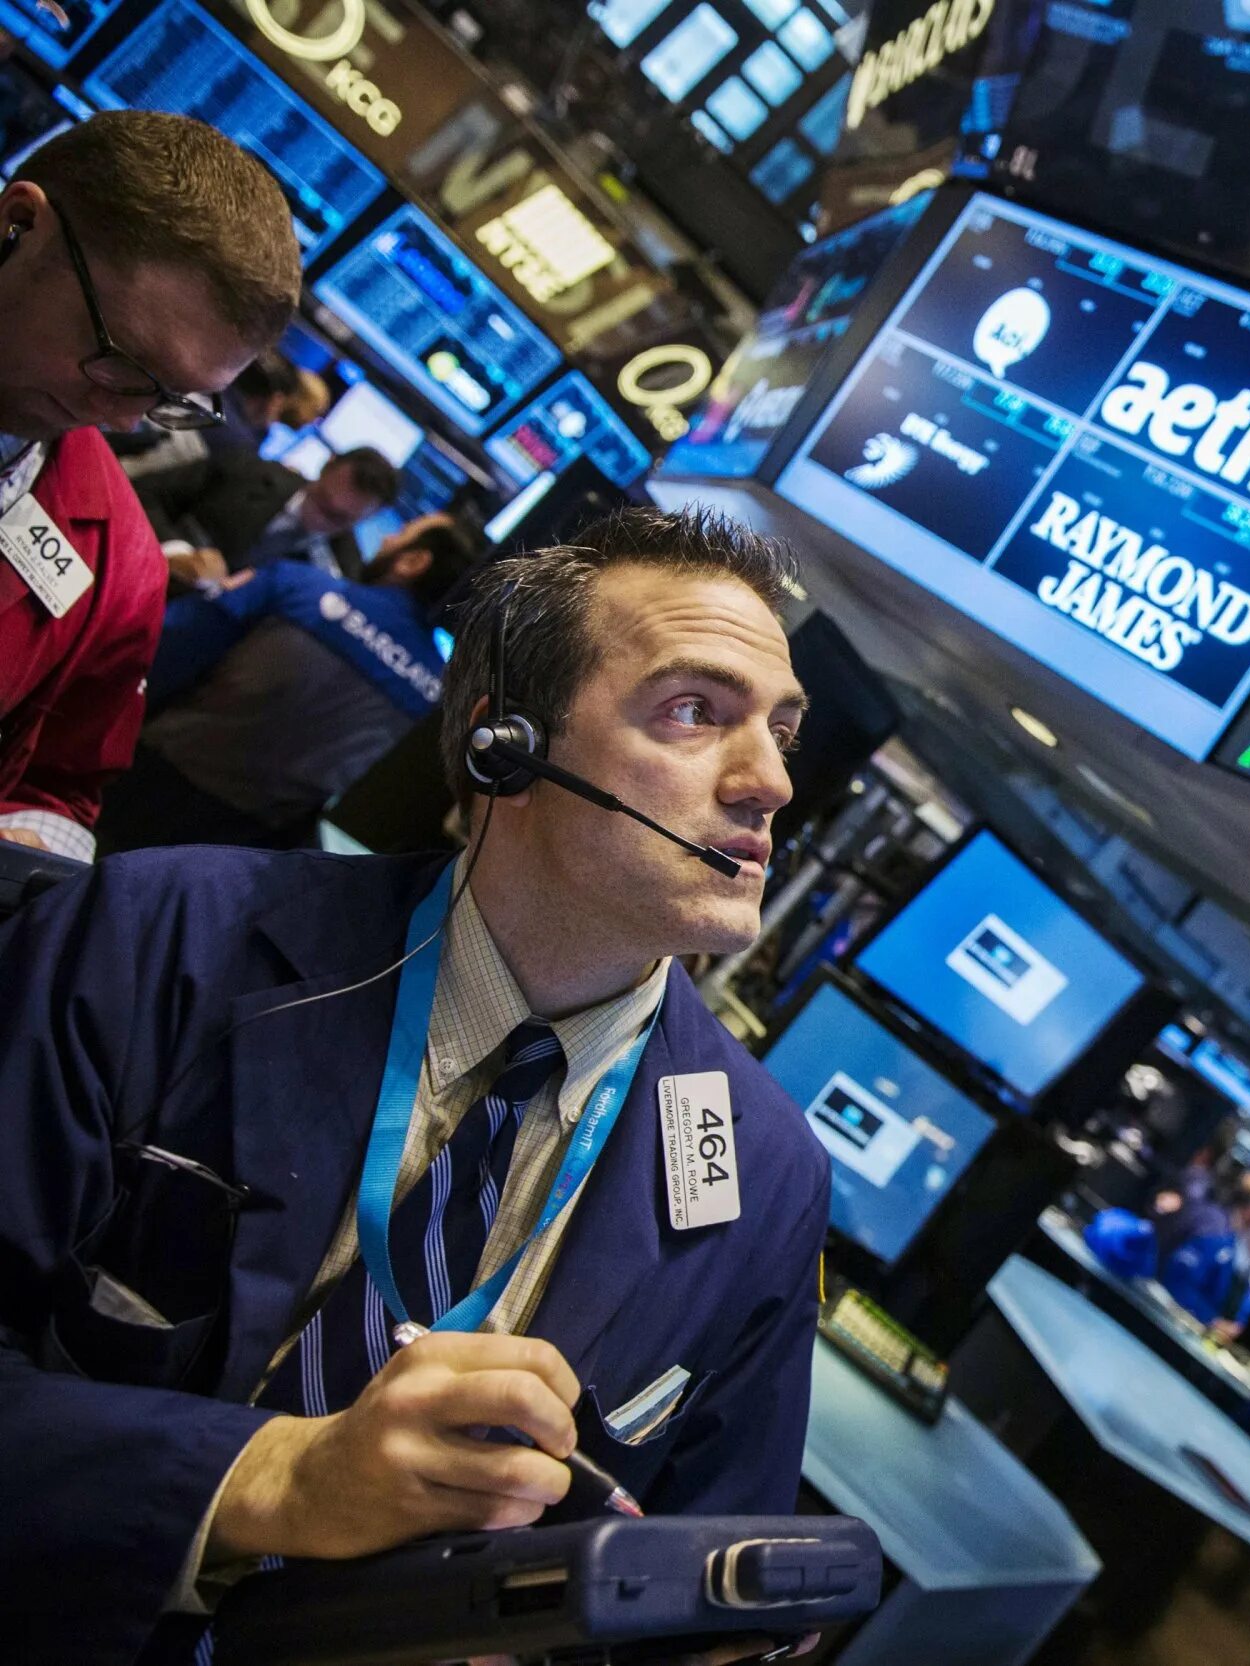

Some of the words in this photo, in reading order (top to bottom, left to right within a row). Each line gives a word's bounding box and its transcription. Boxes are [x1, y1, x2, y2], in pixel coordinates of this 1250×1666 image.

[28, 525, 73, 576] 404
[1038, 560, 1202, 671] JAMES
[579, 1087, 616, 1151] FordhamIT
[662, 1079, 675, 1131] LIVERMORE
[680, 1097, 694, 1151] GREGORY
[668, 1134, 679, 1172] TRADING
[686, 1153, 695, 1167] M.
[697, 1108, 729, 1187] 464
[688, 1169, 699, 1203] ROWE
